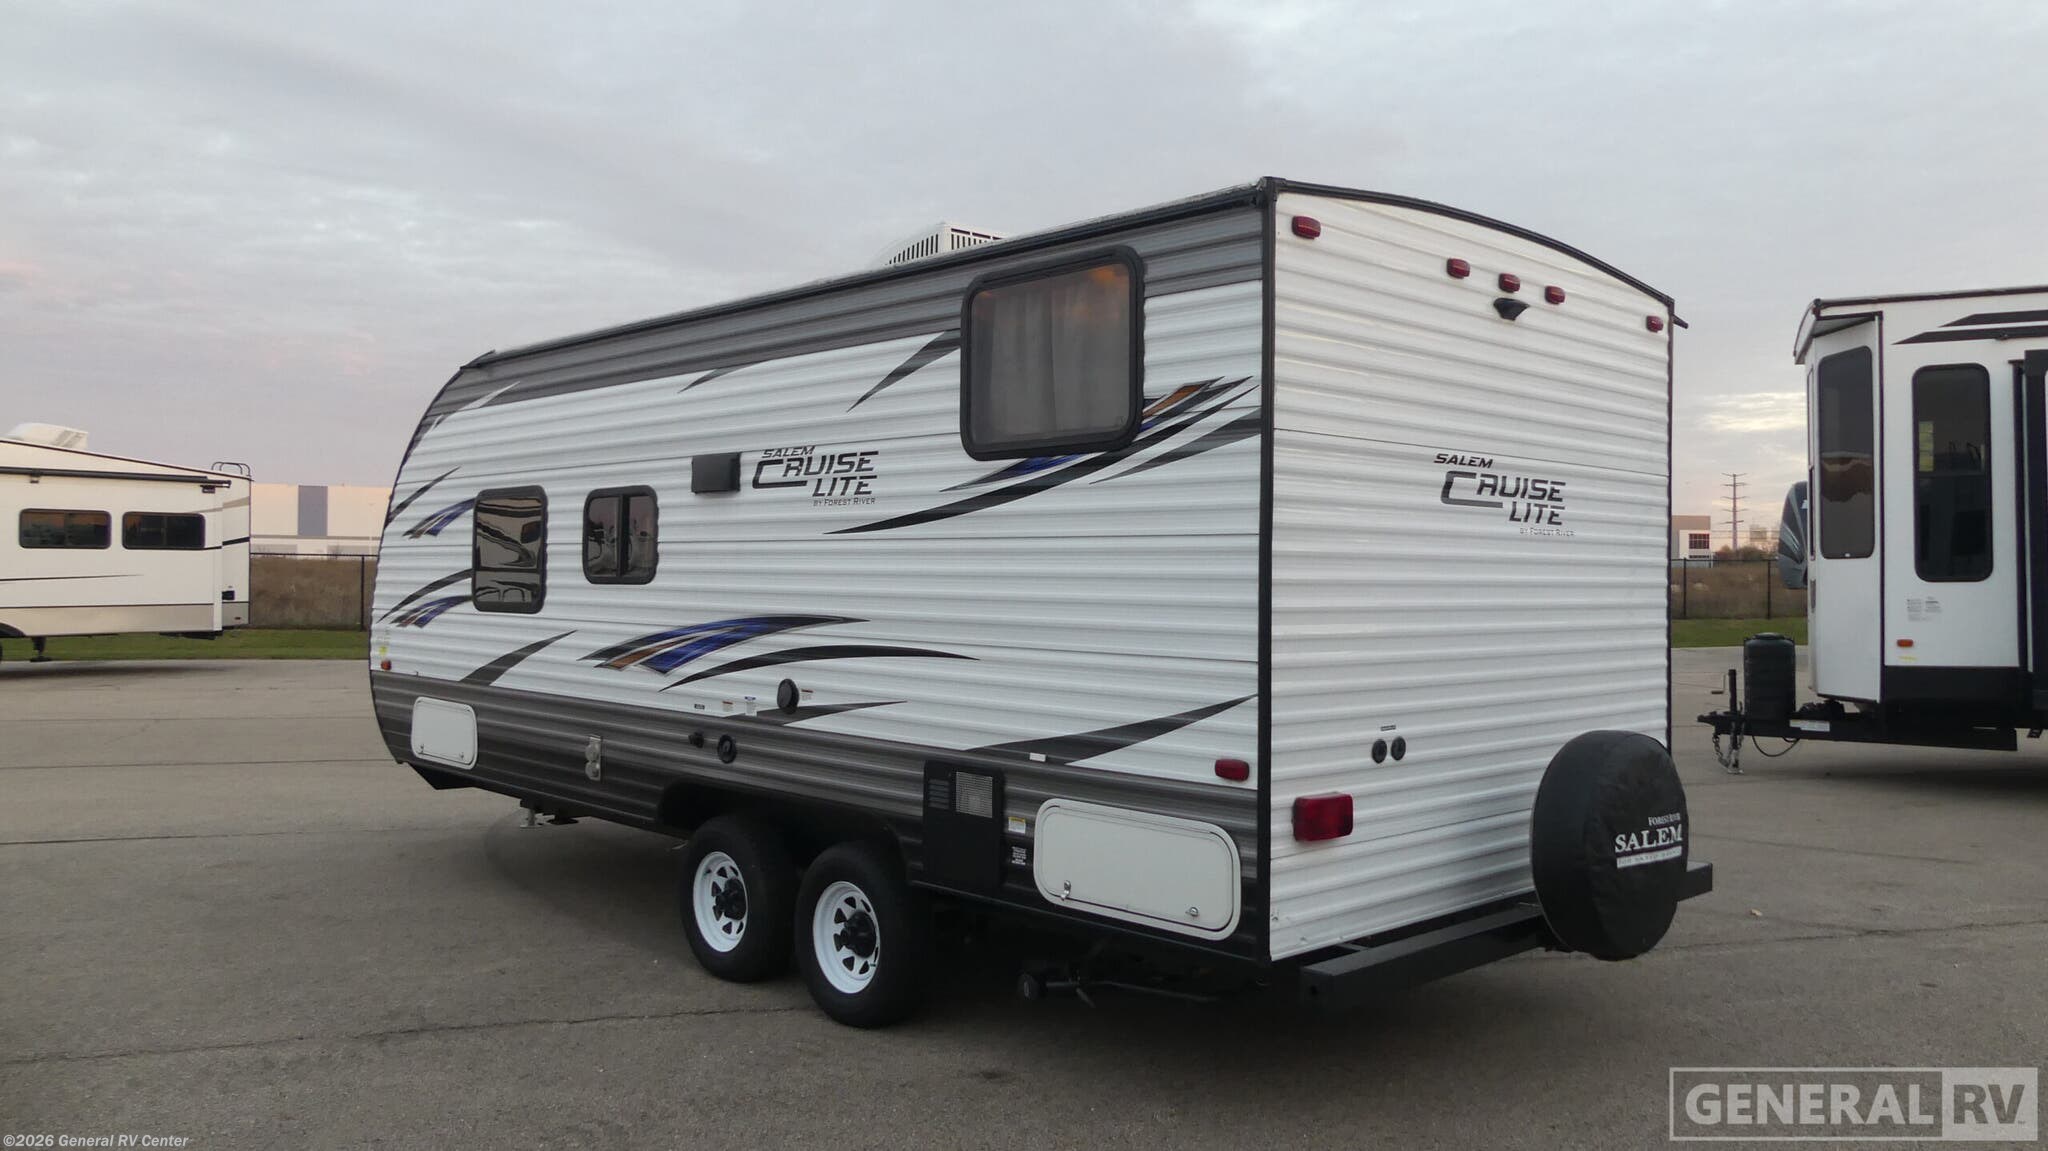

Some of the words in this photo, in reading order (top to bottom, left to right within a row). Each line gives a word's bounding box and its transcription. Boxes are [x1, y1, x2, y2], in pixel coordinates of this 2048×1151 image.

[762, 445, 816, 459] SALEM
[1433, 452, 1494, 469] SALEM
[752, 450, 879, 490] CRUISE
[811, 475, 878, 498] LITE
[1440, 470, 1566, 509] CRUISE
[853, 496, 876, 505] RIVER
[1509, 501, 1566, 526] LITE
[1614, 823, 1683, 853] SALEM
